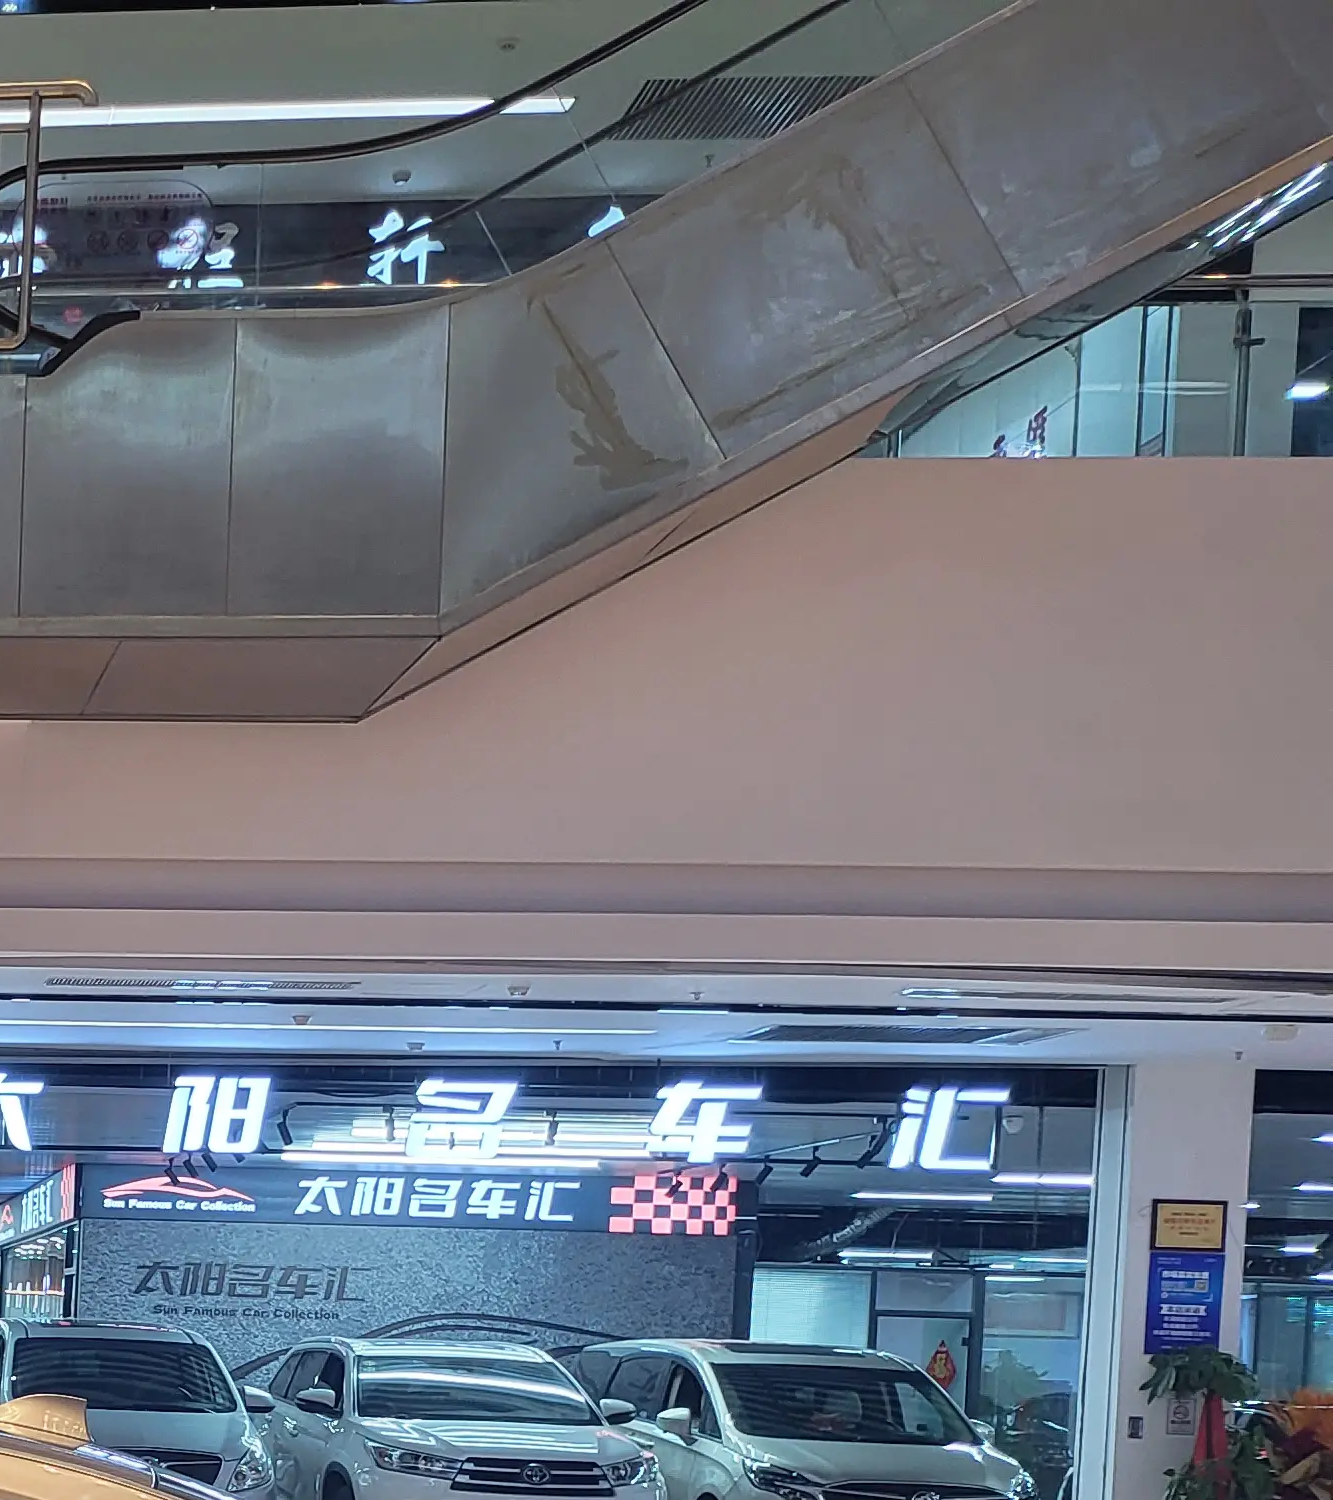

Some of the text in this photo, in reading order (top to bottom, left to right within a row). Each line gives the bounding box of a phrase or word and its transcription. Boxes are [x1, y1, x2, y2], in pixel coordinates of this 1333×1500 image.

[103, 1198, 257, 1212] Sun Famous Car Collection
[293, 1175, 582, 1222] 太阳名车汇
[133, 1261, 372, 1301] 太阳名车汇
[153, 1304, 179, 1315] Sun
[183, 1306, 236, 1319] Famous
[273, 1307, 340, 1320] Collection
